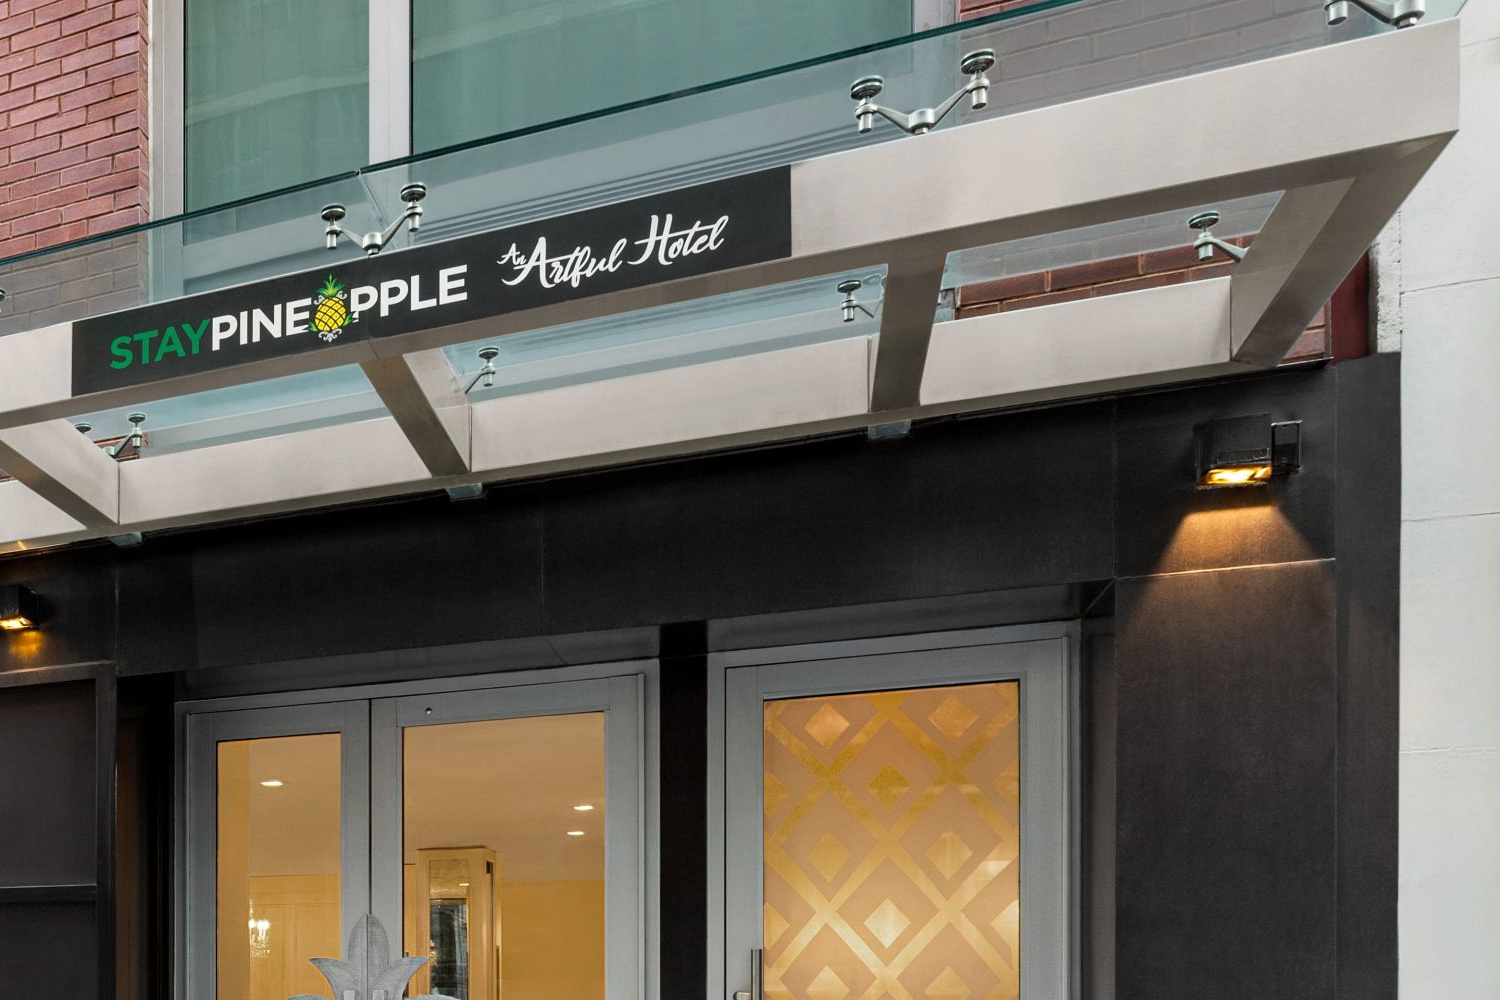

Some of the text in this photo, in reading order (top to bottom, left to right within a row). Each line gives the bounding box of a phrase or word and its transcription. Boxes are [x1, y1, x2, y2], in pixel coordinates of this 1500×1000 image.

[497, 242, 527, 265] An
[501, 236, 627, 288] Artful
[627, 213, 729, 265] Hotel
